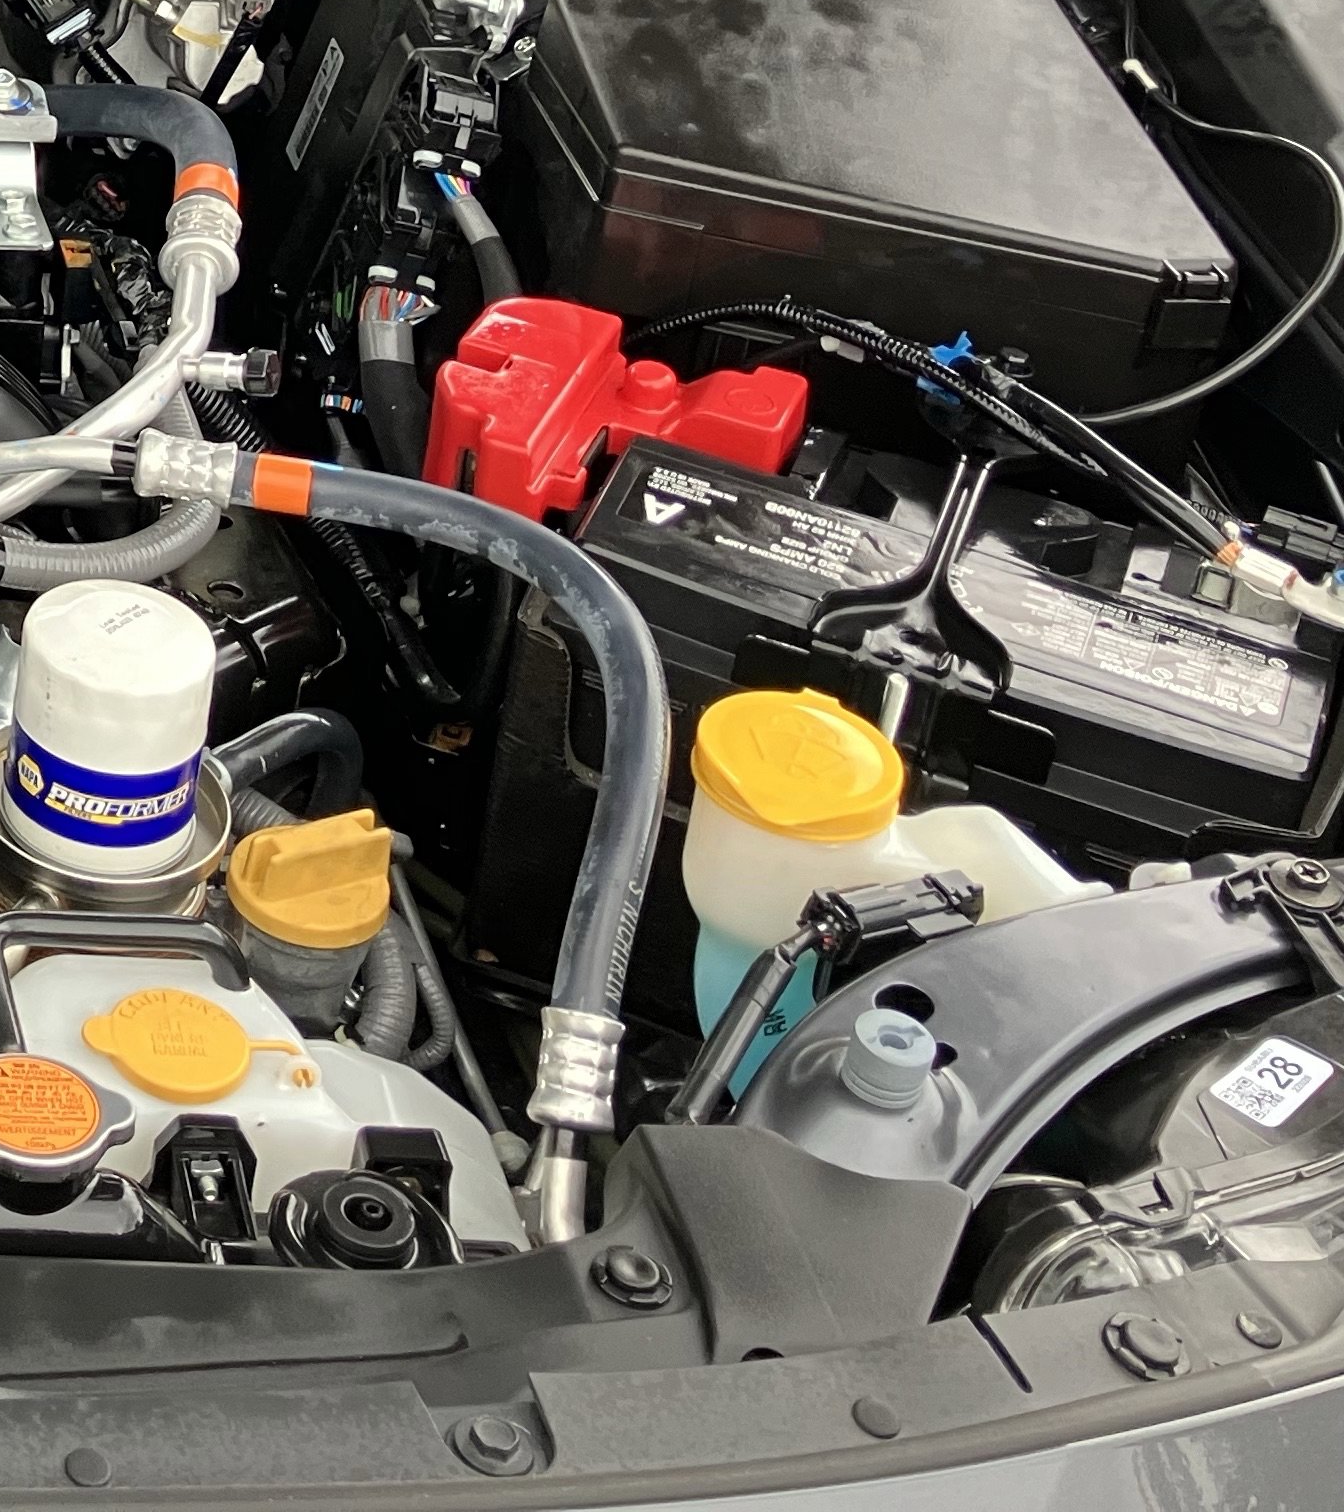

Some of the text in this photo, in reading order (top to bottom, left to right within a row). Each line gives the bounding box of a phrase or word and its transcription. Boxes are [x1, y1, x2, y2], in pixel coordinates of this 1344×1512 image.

[713, 533, 748, 550] AMPS
[768, 541, 816, 564] AMPS
[747, 544, 808, 570] CRANKING
[20, 764, 39, 788] NAPA
[49, 782, 189, 817] PROFORMER
[605, 900, 639, 1004] NICHIRIN
[1257, 1056, 1303, 1090] 28
